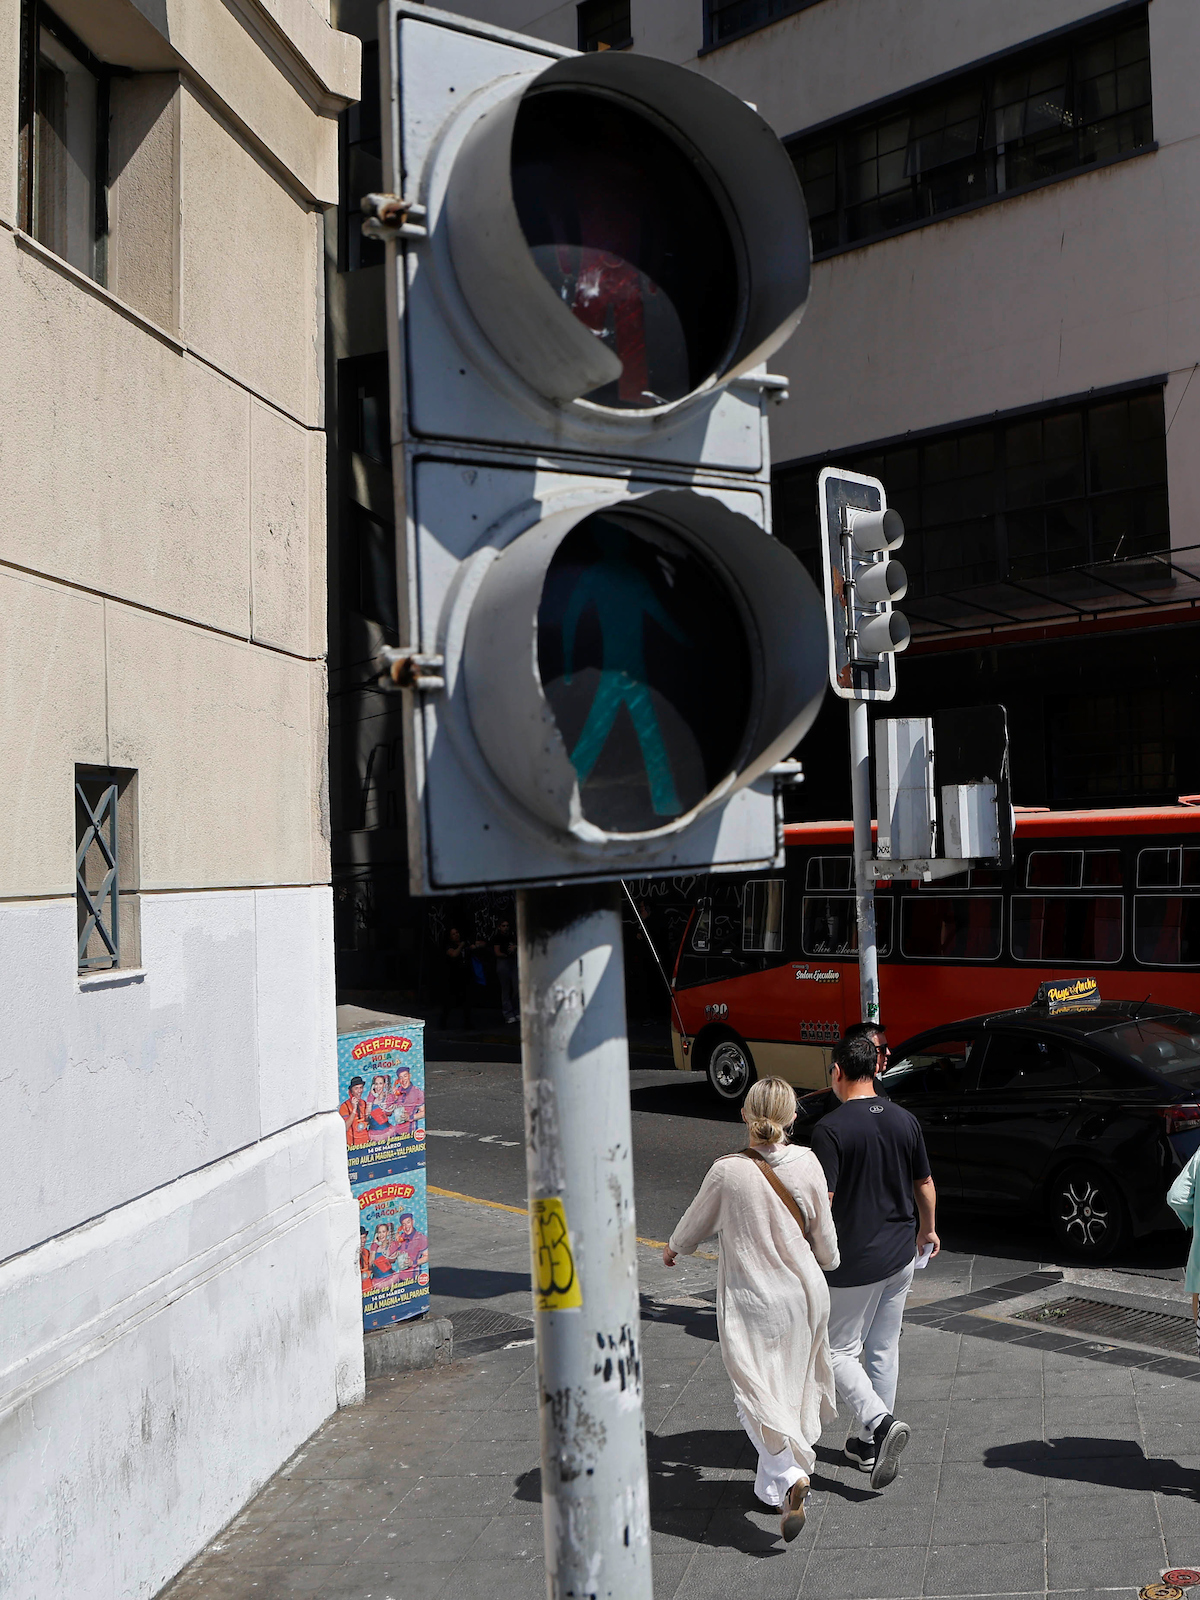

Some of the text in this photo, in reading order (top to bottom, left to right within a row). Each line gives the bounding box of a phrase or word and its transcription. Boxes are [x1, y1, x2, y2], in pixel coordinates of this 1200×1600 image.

[812, 941, 831, 954] Aire
[1047, 978, 1097, 1002] Playa Ancha
[371, 1053, 392, 1062] HOLA
[362, 1058, 401, 1071] CARACOLA
[387, 1131, 414, 1146] familia!
[382, 1142, 402, 1151] MARZO
[360, 1154, 375, 1165] AULA
[374, 1150, 394, 1160] MAGNA
[375, 1201, 395, 1211] HOLA
[366, 1205, 405, 1221] CARACOLA
[386, 1288, 405, 1297] MARZO
[364, 1303, 379, 1313] AULA
[379, 1297, 398, 1309] MAGNA
